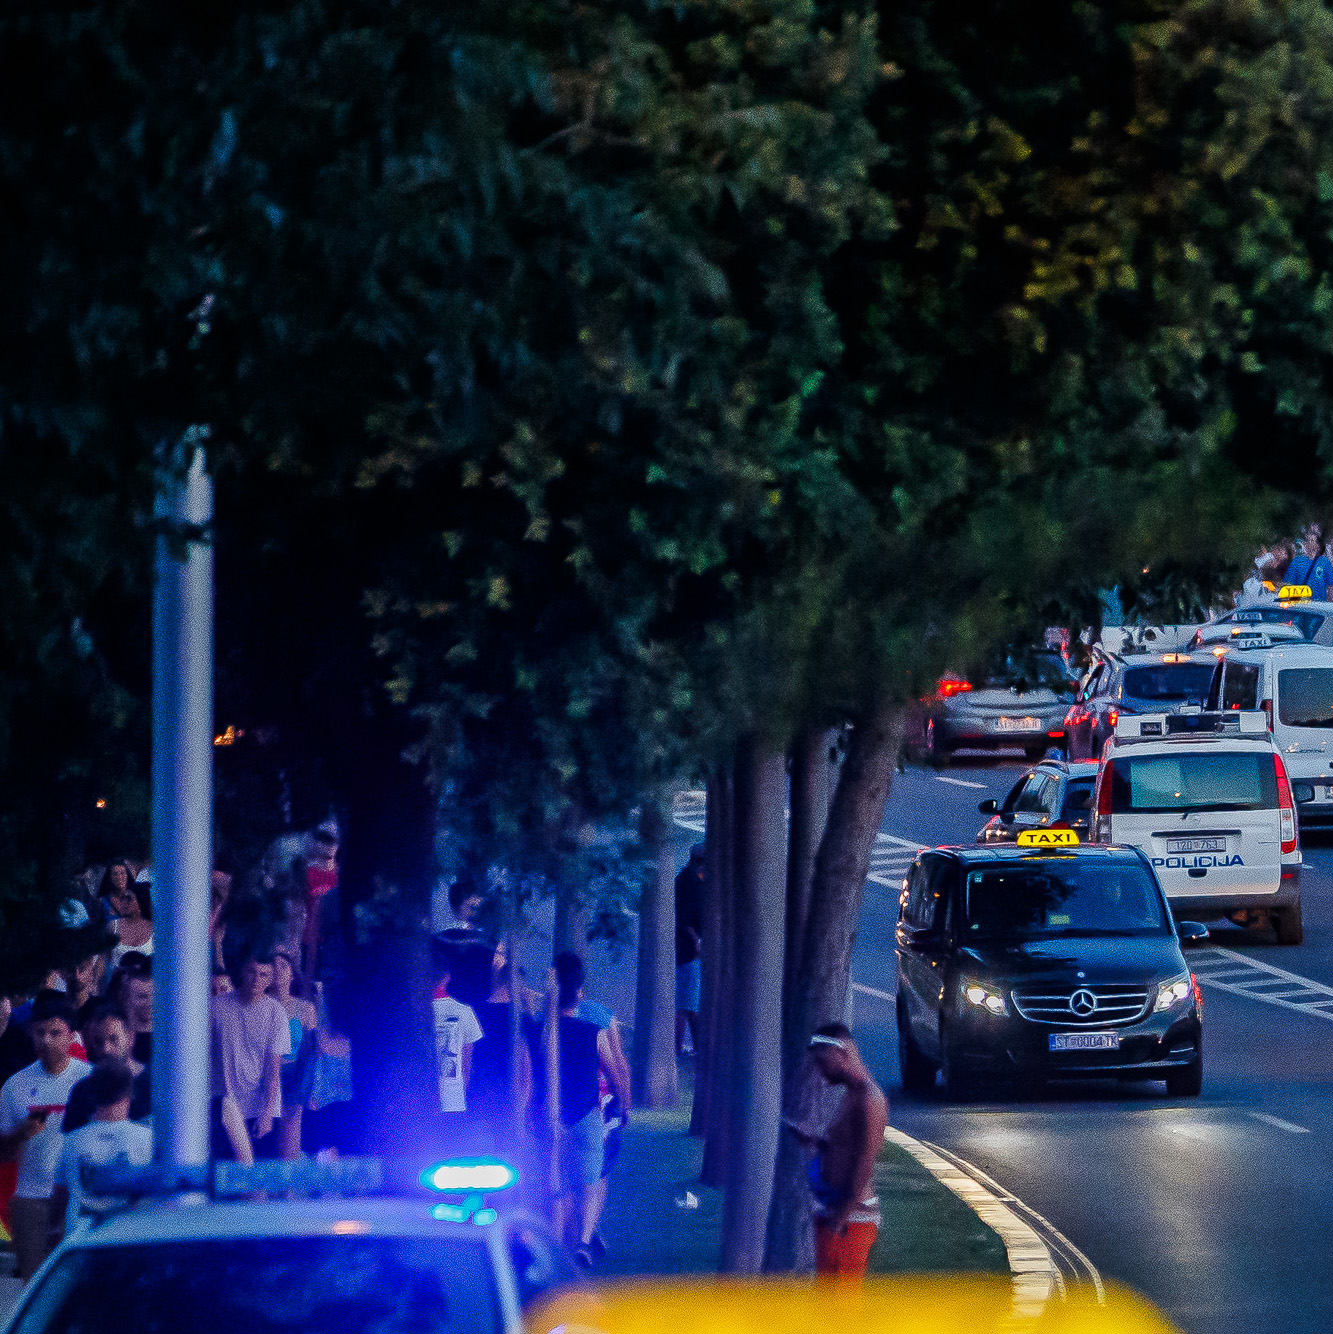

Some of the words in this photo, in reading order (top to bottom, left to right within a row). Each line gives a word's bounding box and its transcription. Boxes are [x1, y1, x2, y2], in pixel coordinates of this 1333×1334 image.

[1285, 586, 1310, 595] TAXI
[1026, 832, 1072, 843] TAXI
[1151, 855, 1245, 869] POLICIJA
